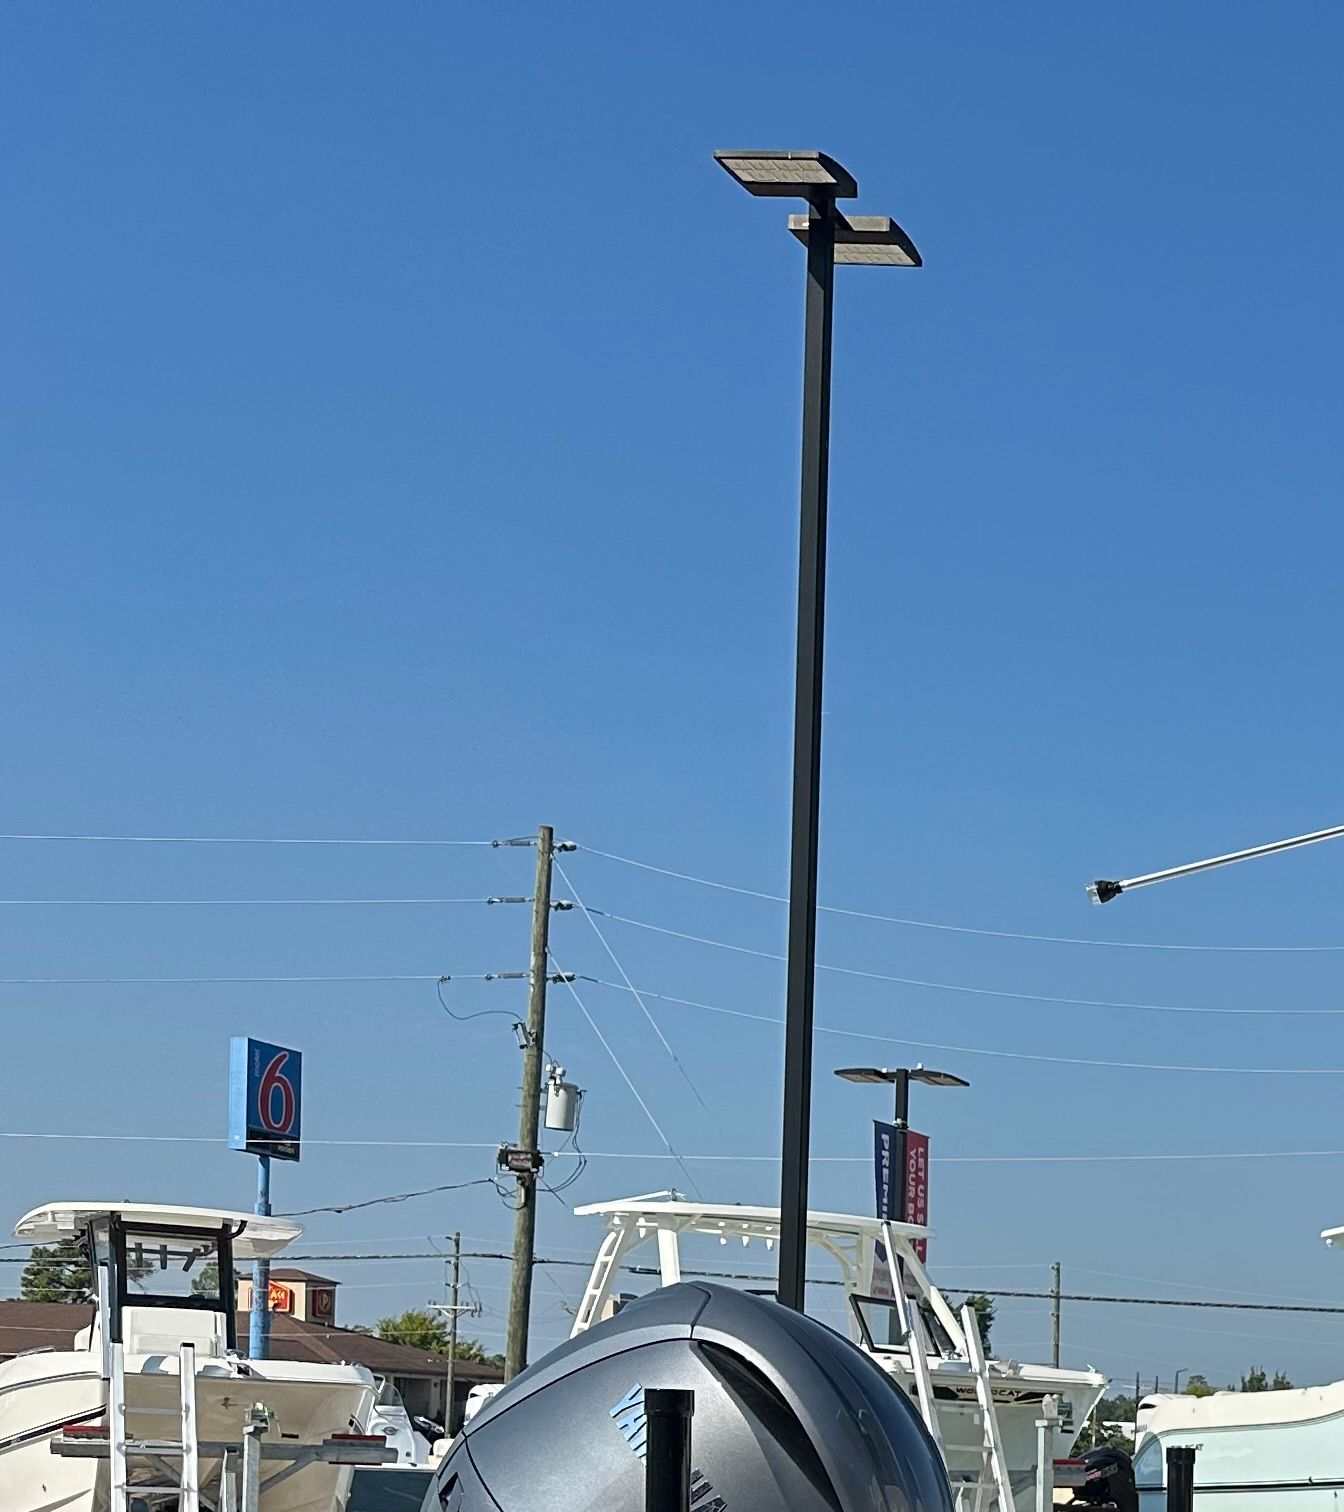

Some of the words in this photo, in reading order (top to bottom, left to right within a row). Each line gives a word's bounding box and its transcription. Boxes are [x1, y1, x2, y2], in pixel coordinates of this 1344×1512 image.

[258, 1050, 295, 1134] 6
[881, 1133, 890, 1221] PREMI
[908, 1148, 917, 1199] YOUR
[917, 1146, 925, 1181] LET
[917, 1184, 925, 1208] US
